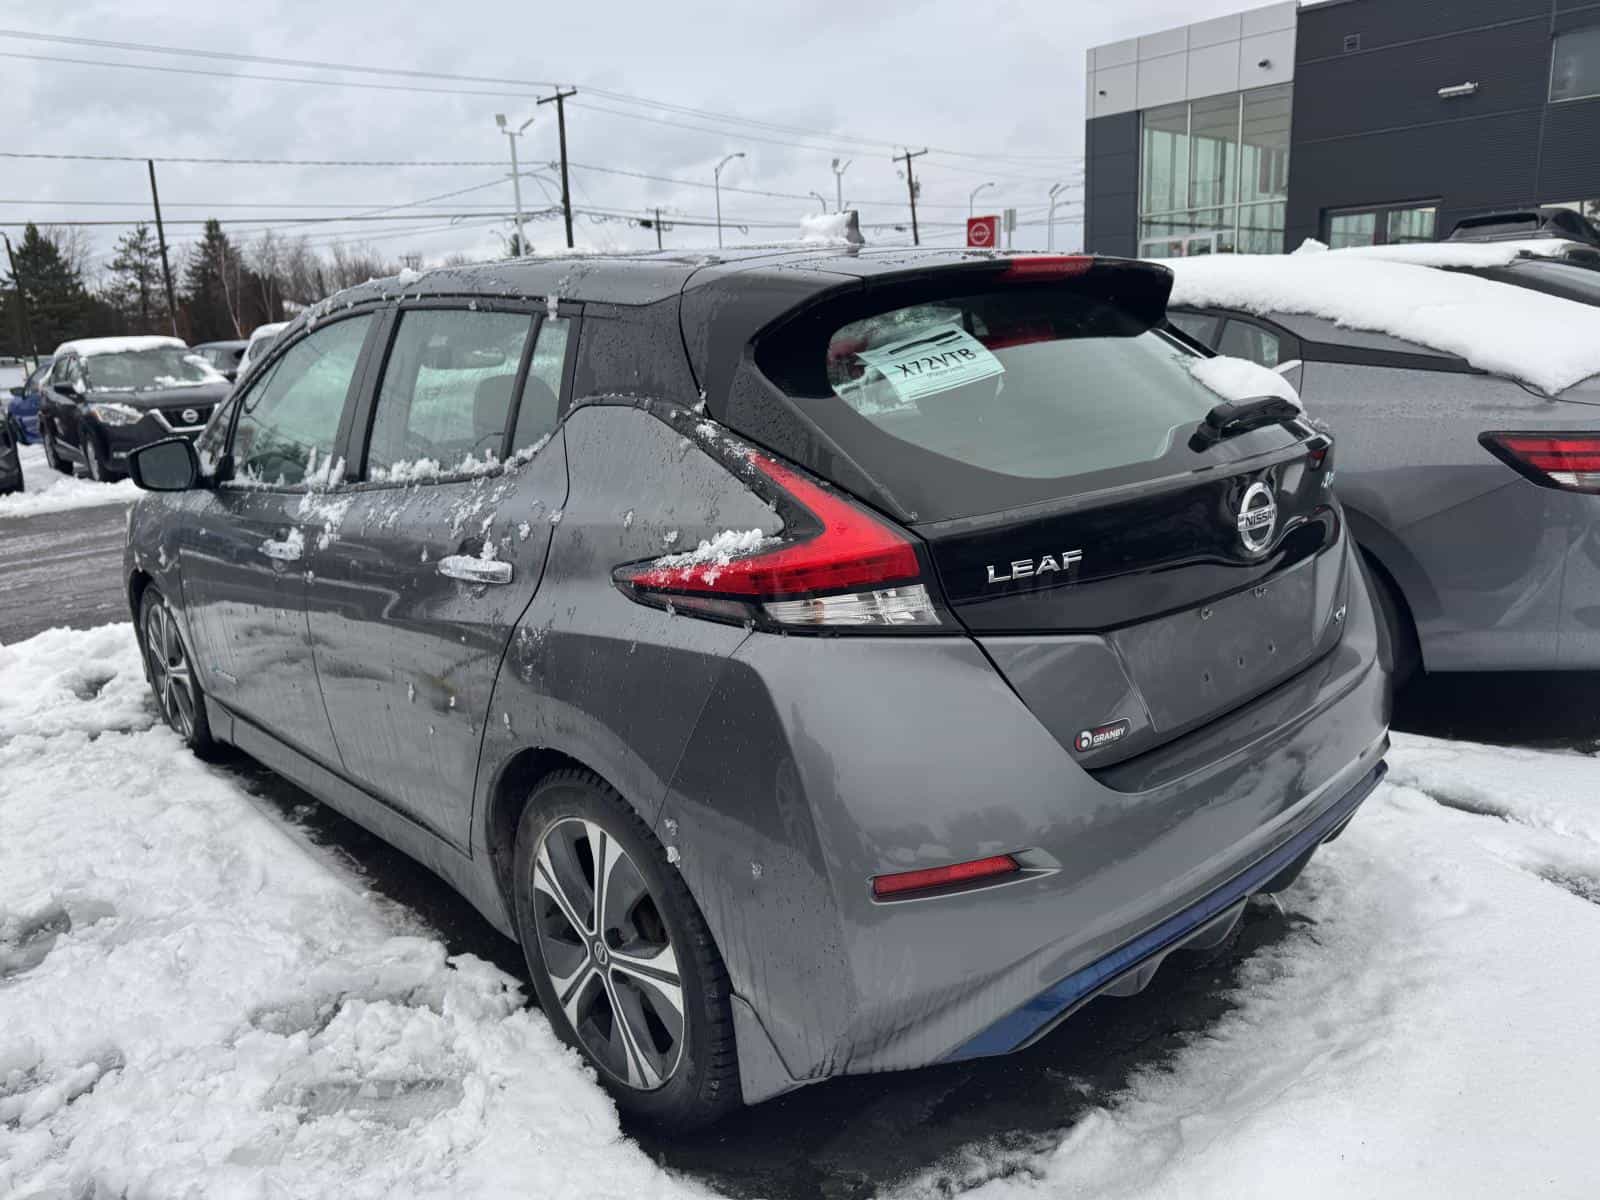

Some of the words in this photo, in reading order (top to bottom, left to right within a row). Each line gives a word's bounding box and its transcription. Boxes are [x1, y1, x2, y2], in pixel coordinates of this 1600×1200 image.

[1245, 506, 1276, 528] NISSAN
[986, 549, 1083, 584] LEAF
[1093, 725, 1126, 743] GRANBY
